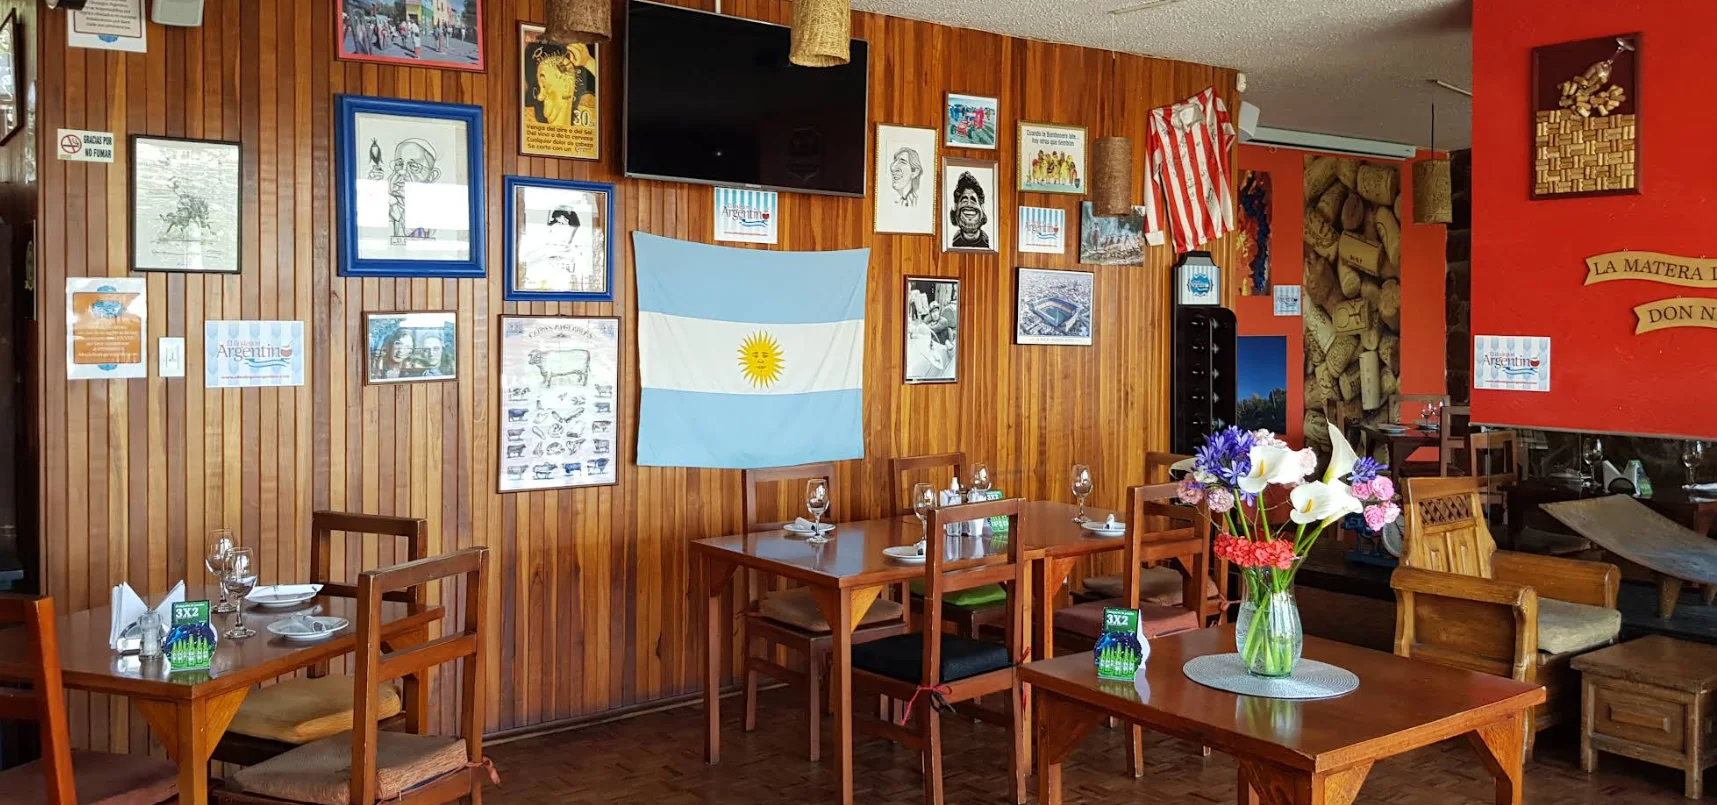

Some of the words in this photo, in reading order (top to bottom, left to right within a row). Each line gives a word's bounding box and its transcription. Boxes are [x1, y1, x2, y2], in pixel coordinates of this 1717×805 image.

[573, 110, 590, 127] 30
[84, 135, 102, 144] GRACIAS
[103, 136, 112, 145] POR
[85, 148, 92, 157] NO
[94, 149, 112, 158] FUMAR
[1593, 260, 1618, 275] LA
[1624, 259, 1703, 280] MATERA
[1648, 305, 1693, 323] DON
[1700, 305, 1717, 321] N
[176, 607, 199, 618] 3X2
[1107, 614, 1128, 625] 3X2
